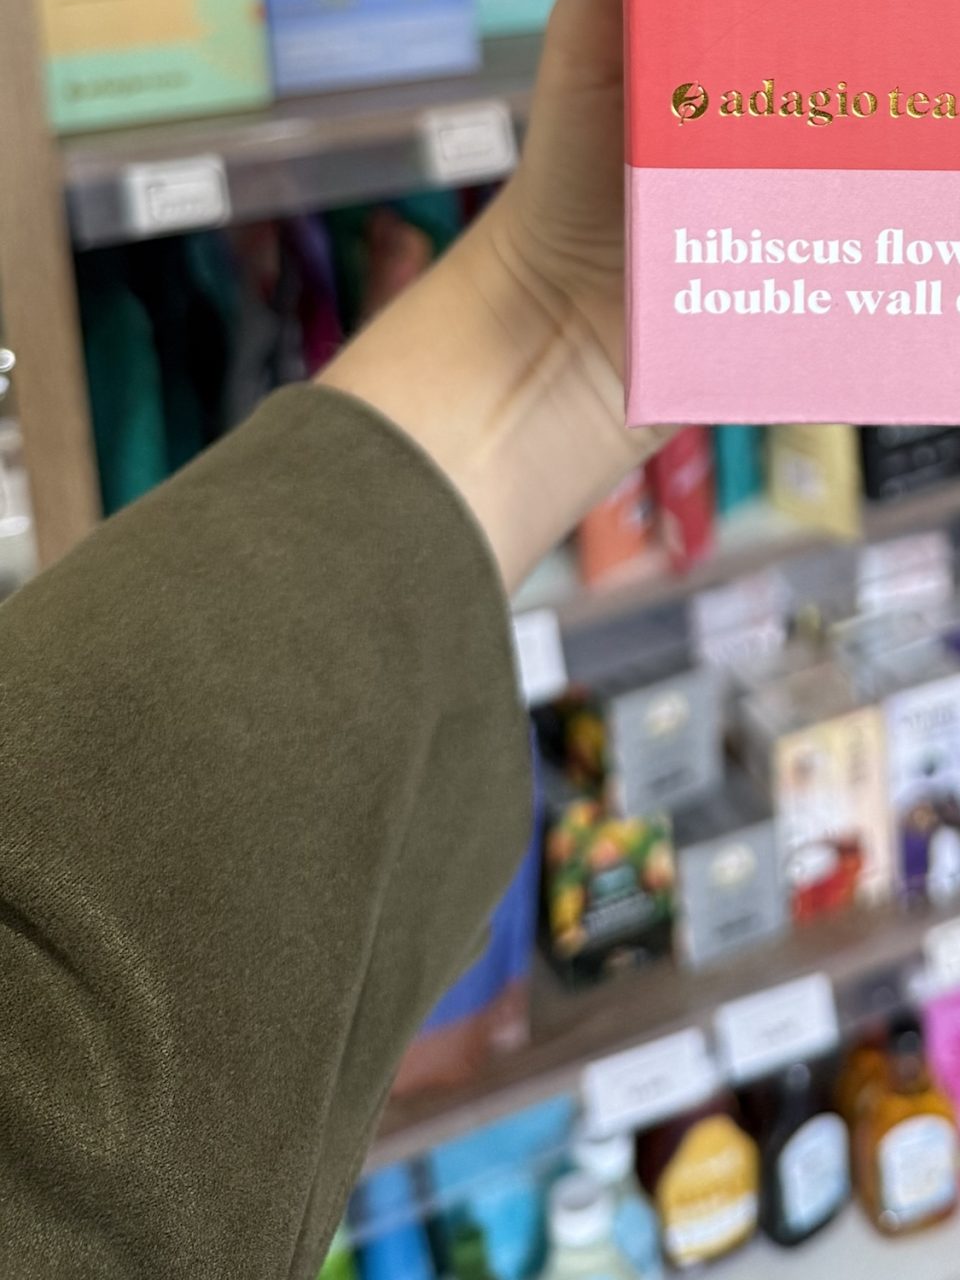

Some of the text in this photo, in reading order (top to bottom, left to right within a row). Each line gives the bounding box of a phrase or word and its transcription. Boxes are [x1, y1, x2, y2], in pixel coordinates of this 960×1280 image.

[719, 78, 879, 127] adagio
[675, 228, 862, 265] hibiscus
[674, 278, 831, 315] double
[846, 279, 942, 316] wall
